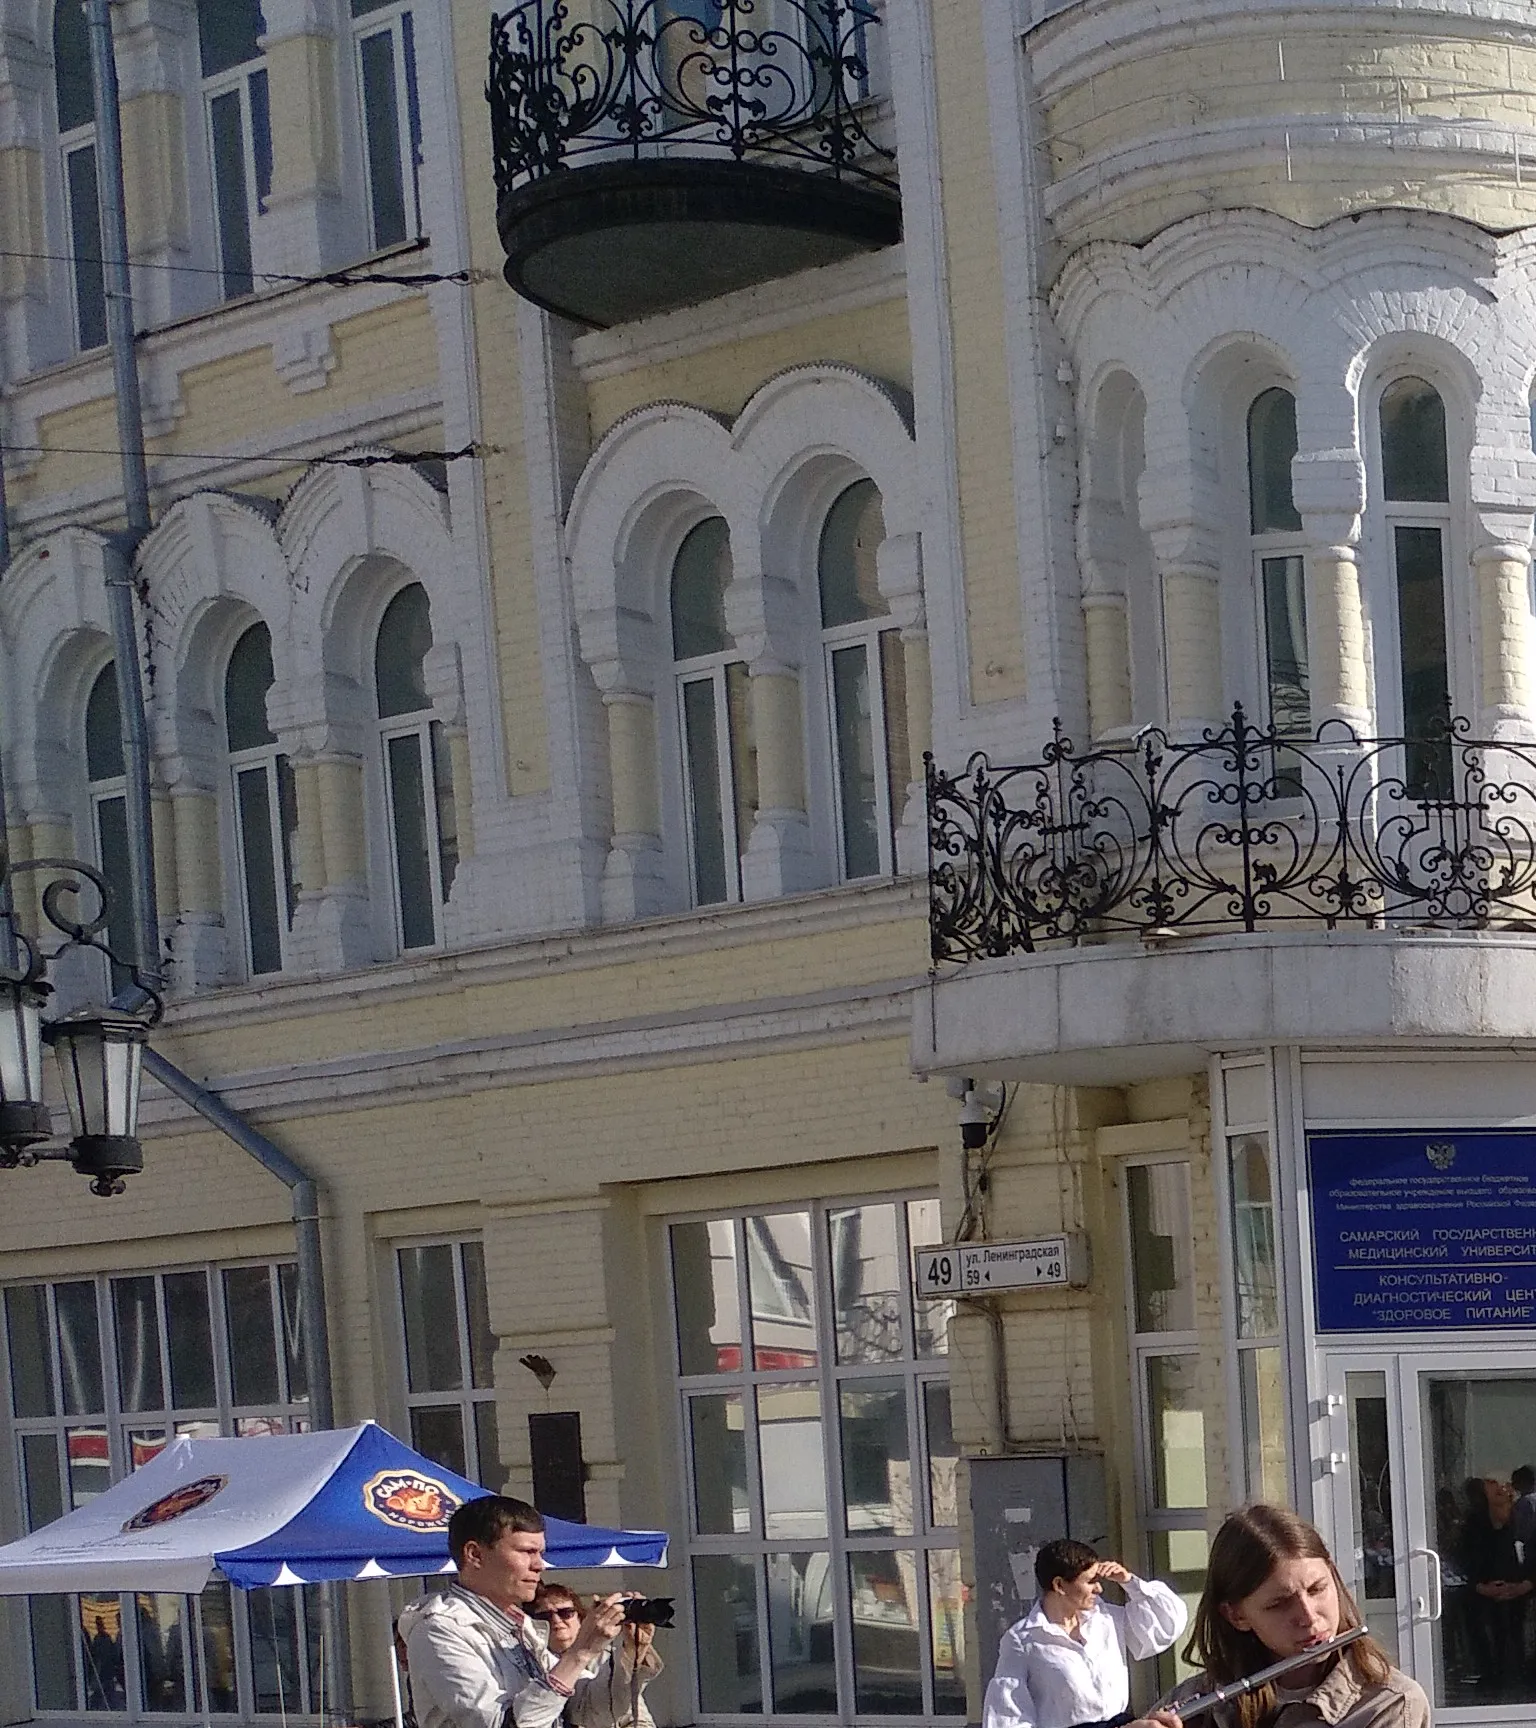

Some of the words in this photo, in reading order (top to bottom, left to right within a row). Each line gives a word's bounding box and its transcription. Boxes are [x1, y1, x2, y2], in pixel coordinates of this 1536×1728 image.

[1340, 1228, 1420, 1243] САМАРСКИЙ
[966, 1252, 981, 1268] ул.
[983, 1245, 1060, 1263] Ленинградская
[1348, 1244, 1448, 1260] МЕДИЦИНСКИЙ
[927, 1257, 952, 1286] 49
[966, 1270, 980, 1286] 59
[1047, 1262, 1061, 1278] 49
[1379, 1272, 1509, 1286] КОНСУЛЬТАТИВНО-
[1353, 1289, 1492, 1306] ДИАГНОСТИЧЕСКИЙ
[1372, 1307, 1451, 1322] "ЗДОРОВОЕ
[1465, 1306, 1535, 1319] ПИТАНИЕ"
